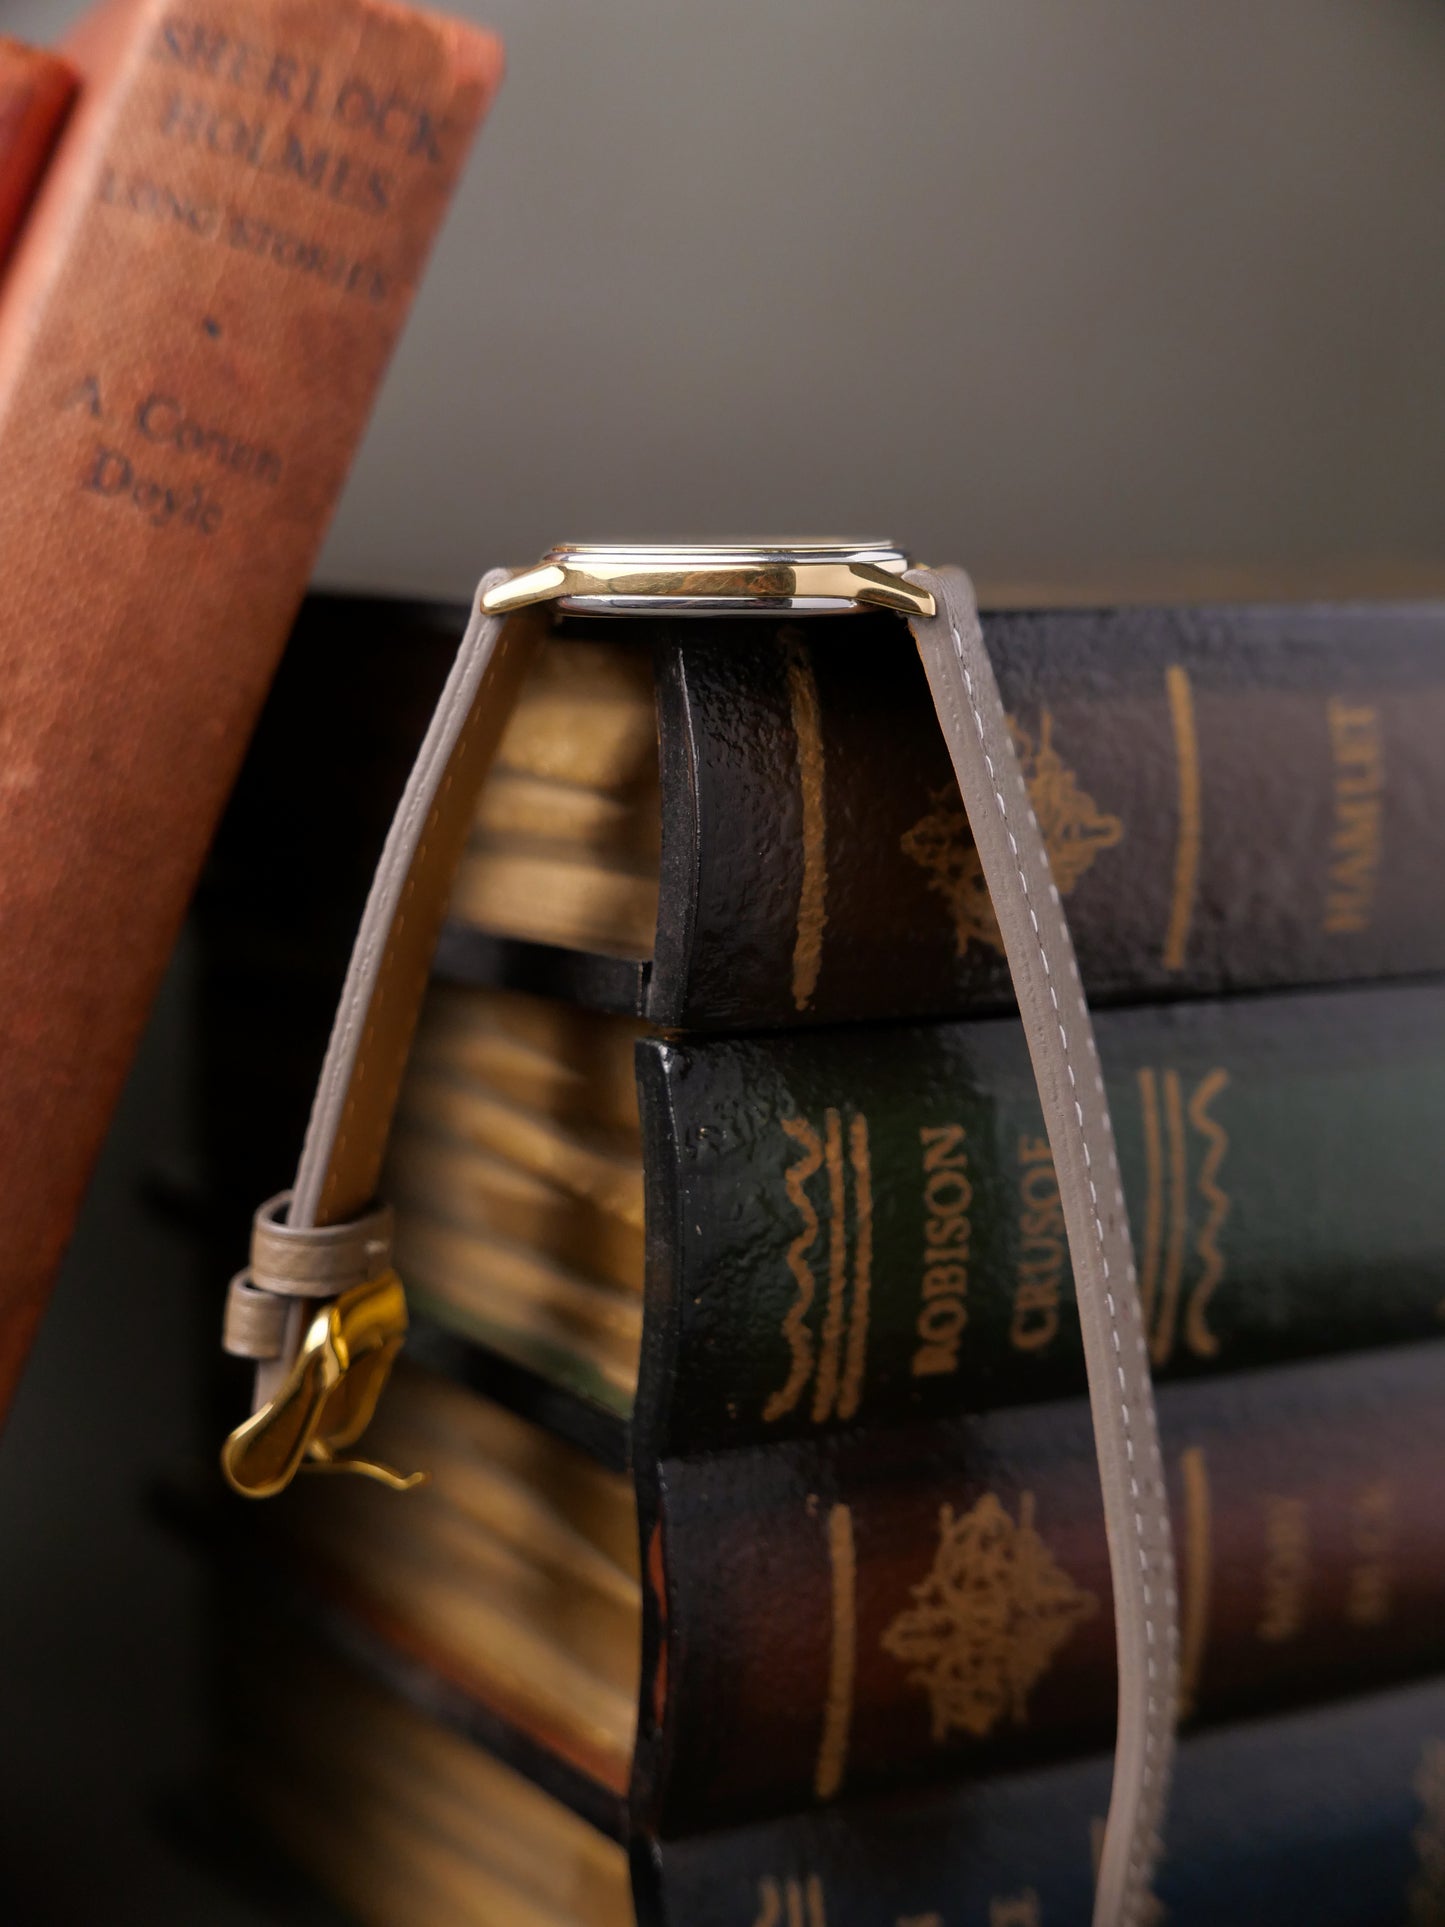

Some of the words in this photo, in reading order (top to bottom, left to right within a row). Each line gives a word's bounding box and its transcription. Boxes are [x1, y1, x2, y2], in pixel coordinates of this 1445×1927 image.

[88, 443, 224, 534] Doyle
[1325, 698, 1381, 931] HAMLET
[911, 1123, 972, 1376] ROBISON
